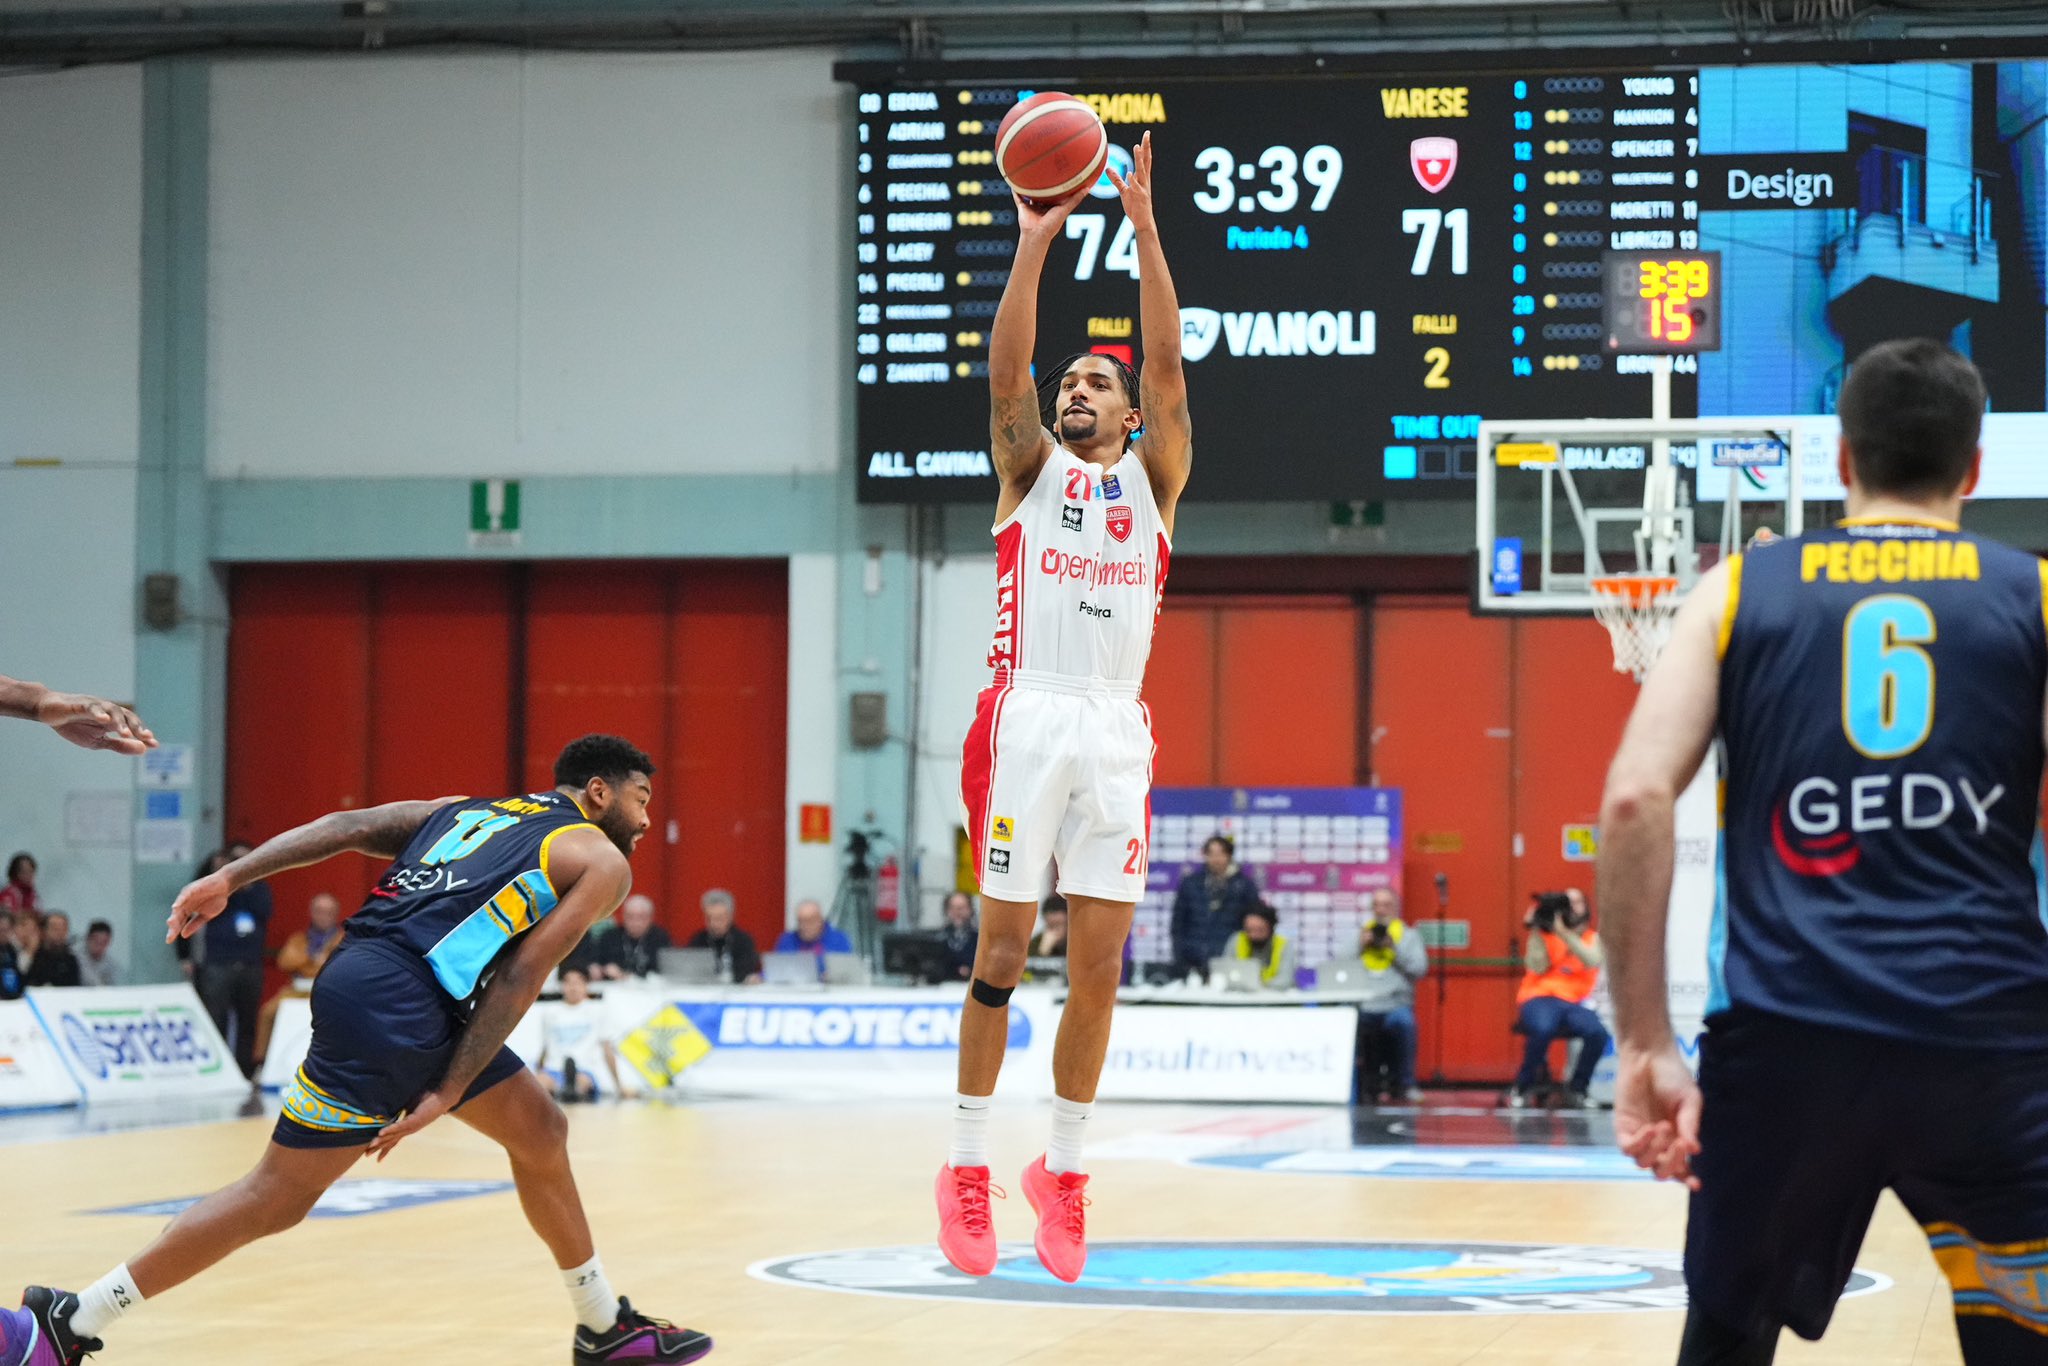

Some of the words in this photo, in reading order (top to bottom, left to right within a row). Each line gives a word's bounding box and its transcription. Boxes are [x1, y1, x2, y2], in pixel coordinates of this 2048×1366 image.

[1622, 77, 1674, 96] YOUNG
[1689, 76, 1698, 95] 1
[1381, 87, 1469, 118] VARESE
[1685, 107, 1698, 126] 4
[859, 123, 869, 143] 1
[1612, 140, 1674, 158] SPENCER
[1686, 138, 1698, 157] 7
[858, 153, 872, 173] 3
[1194, 145, 1343, 214] 3:39
[1727, 167, 1834, 206] Design
[858, 184, 872, 204] 6
[887, 182, 951, 201] PECCHIA
[1513, 204, 1526, 223] 3
[1611, 201, 1674, 219] MORETTI
[1682, 200, 1697, 220] 11
[1066, 214, 1140, 280] 74
[1227, 226, 1293, 249] Periodo
[1293, 225, 1309, 248] 4
[1402, 208, 1468, 275] 71
[887, 242, 935, 262] LACEY
[858, 273, 878, 294] 14
[887, 272, 945, 292] PICCOLI
[1640, 261, 1709, 298] 3:39
[858, 303, 880, 324] 22
[1412, 314, 1457, 335] FALLI
[1650, 296, 1692, 341] 15
[1087, 317, 1132, 337] FALLI
[1222, 311, 1376, 356] VANOLI
[1512, 326, 1525, 346] 9
[886, 363, 950, 383] ZANOTTI
[1424, 347, 1451, 389] 2
[1674, 354, 1697, 374] 44
[1391, 415, 1440, 439] TIME
[1441, 415, 1482, 439] OUT
[868, 451, 915, 477] ALL.
[915, 450, 992, 477] CAVINA
[1064, 467, 1092, 502] 21
[1801, 539, 1981, 583] PECCHIA
[1841, 592, 1937, 760] 6
[1788, 773, 2005, 836] GEDY
[112, 1284, 132, 1309] 23
